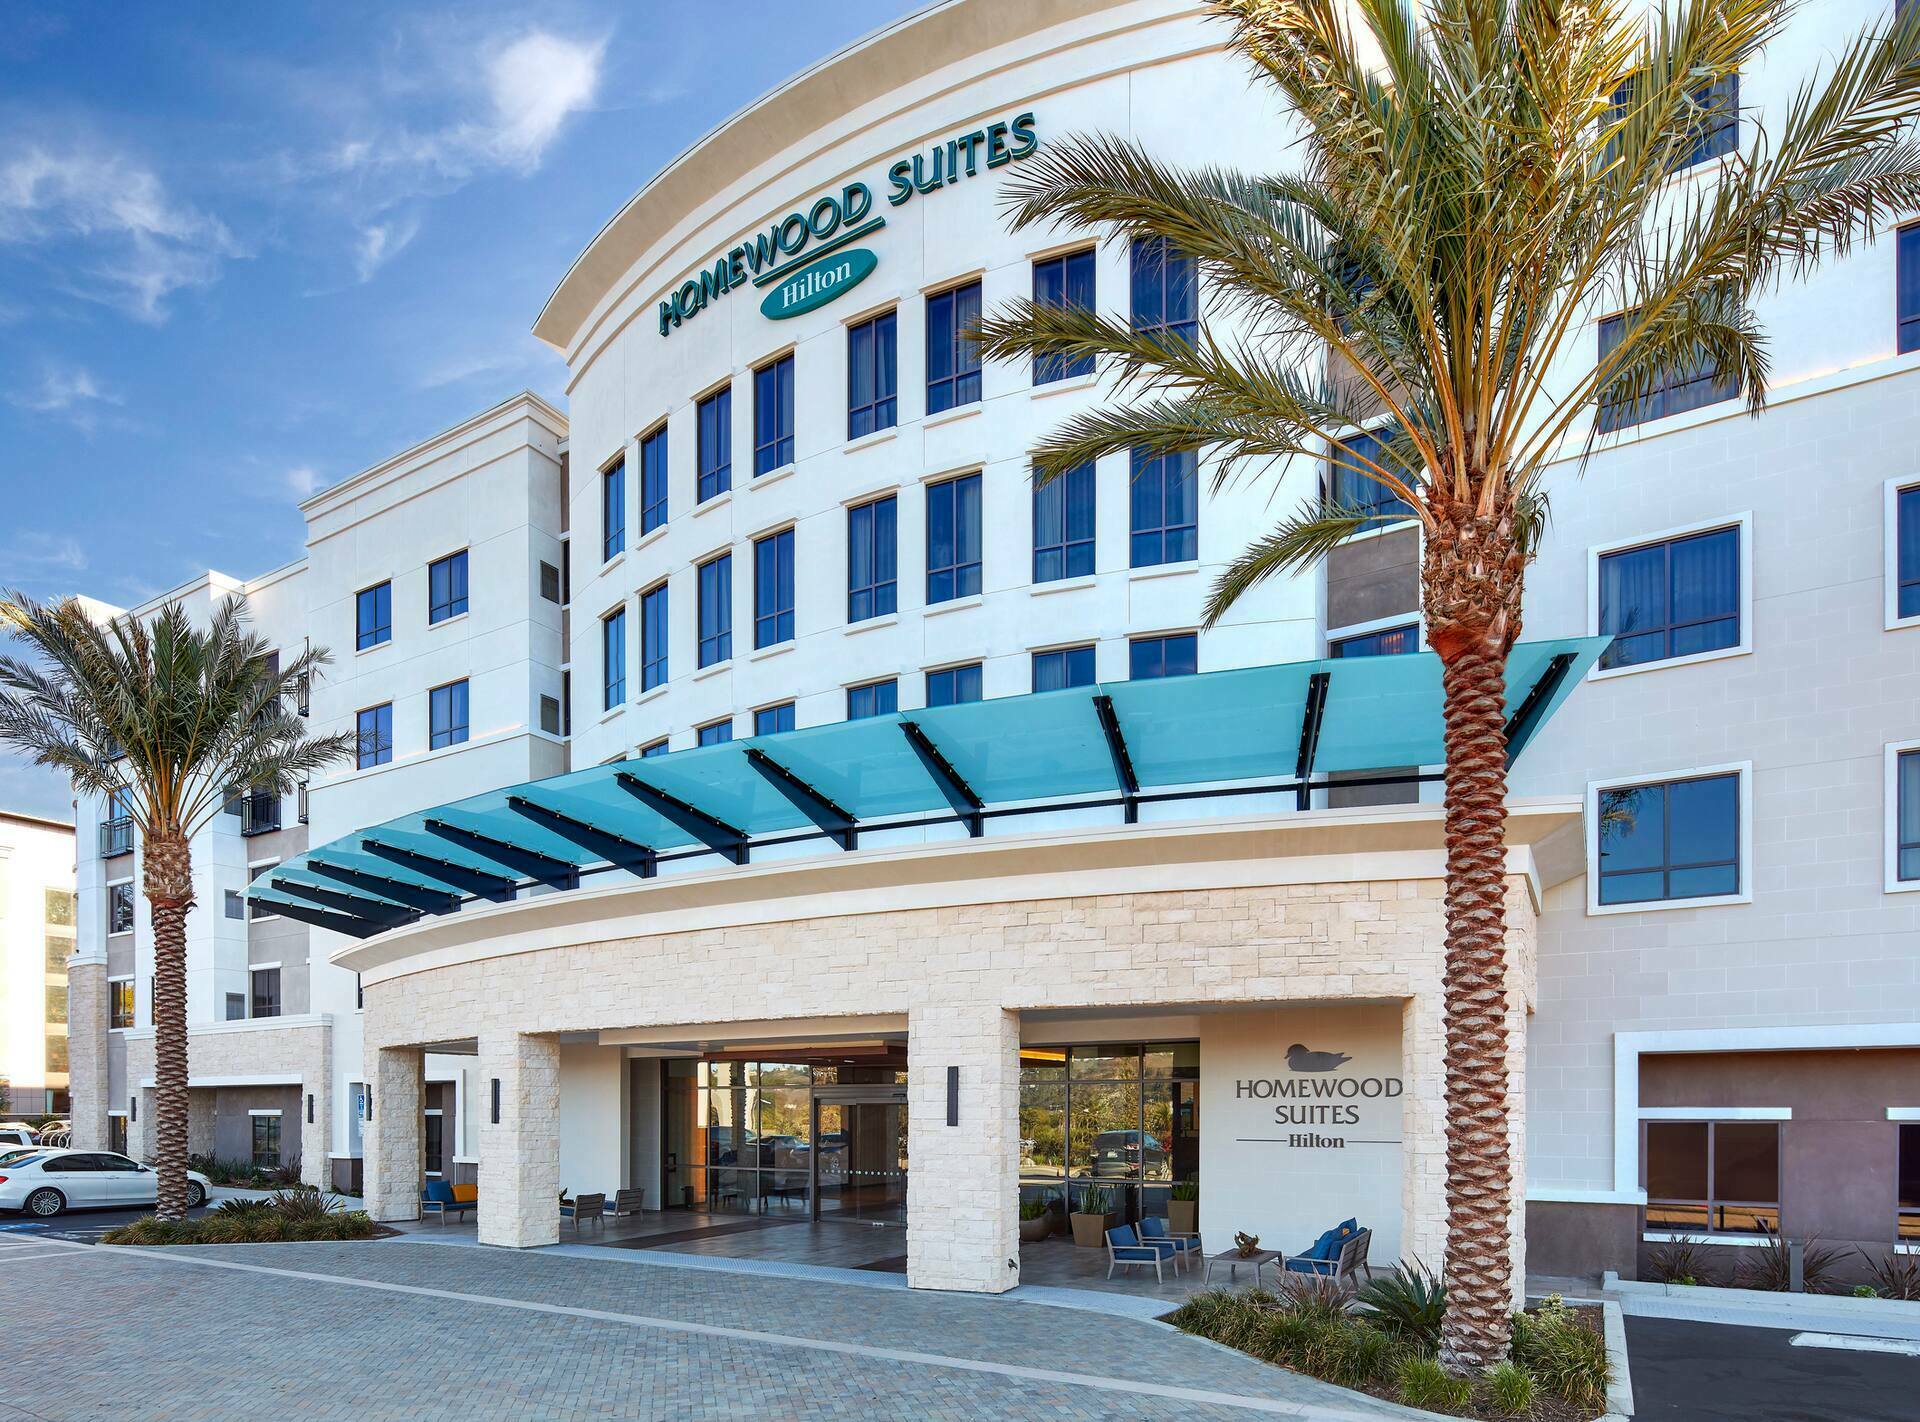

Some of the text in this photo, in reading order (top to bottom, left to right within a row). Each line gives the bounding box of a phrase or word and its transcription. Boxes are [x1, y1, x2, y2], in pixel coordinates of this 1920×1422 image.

[658, 112, 1038, 337] HOMEWOOD SUITES
[780, 262, 852, 309] Hilton
[1236, 1078, 1403, 1099] HOMEWOOD
[1275, 1105, 1360, 1125] SUITES
[1288, 1133, 1345, 1149] Hilton
